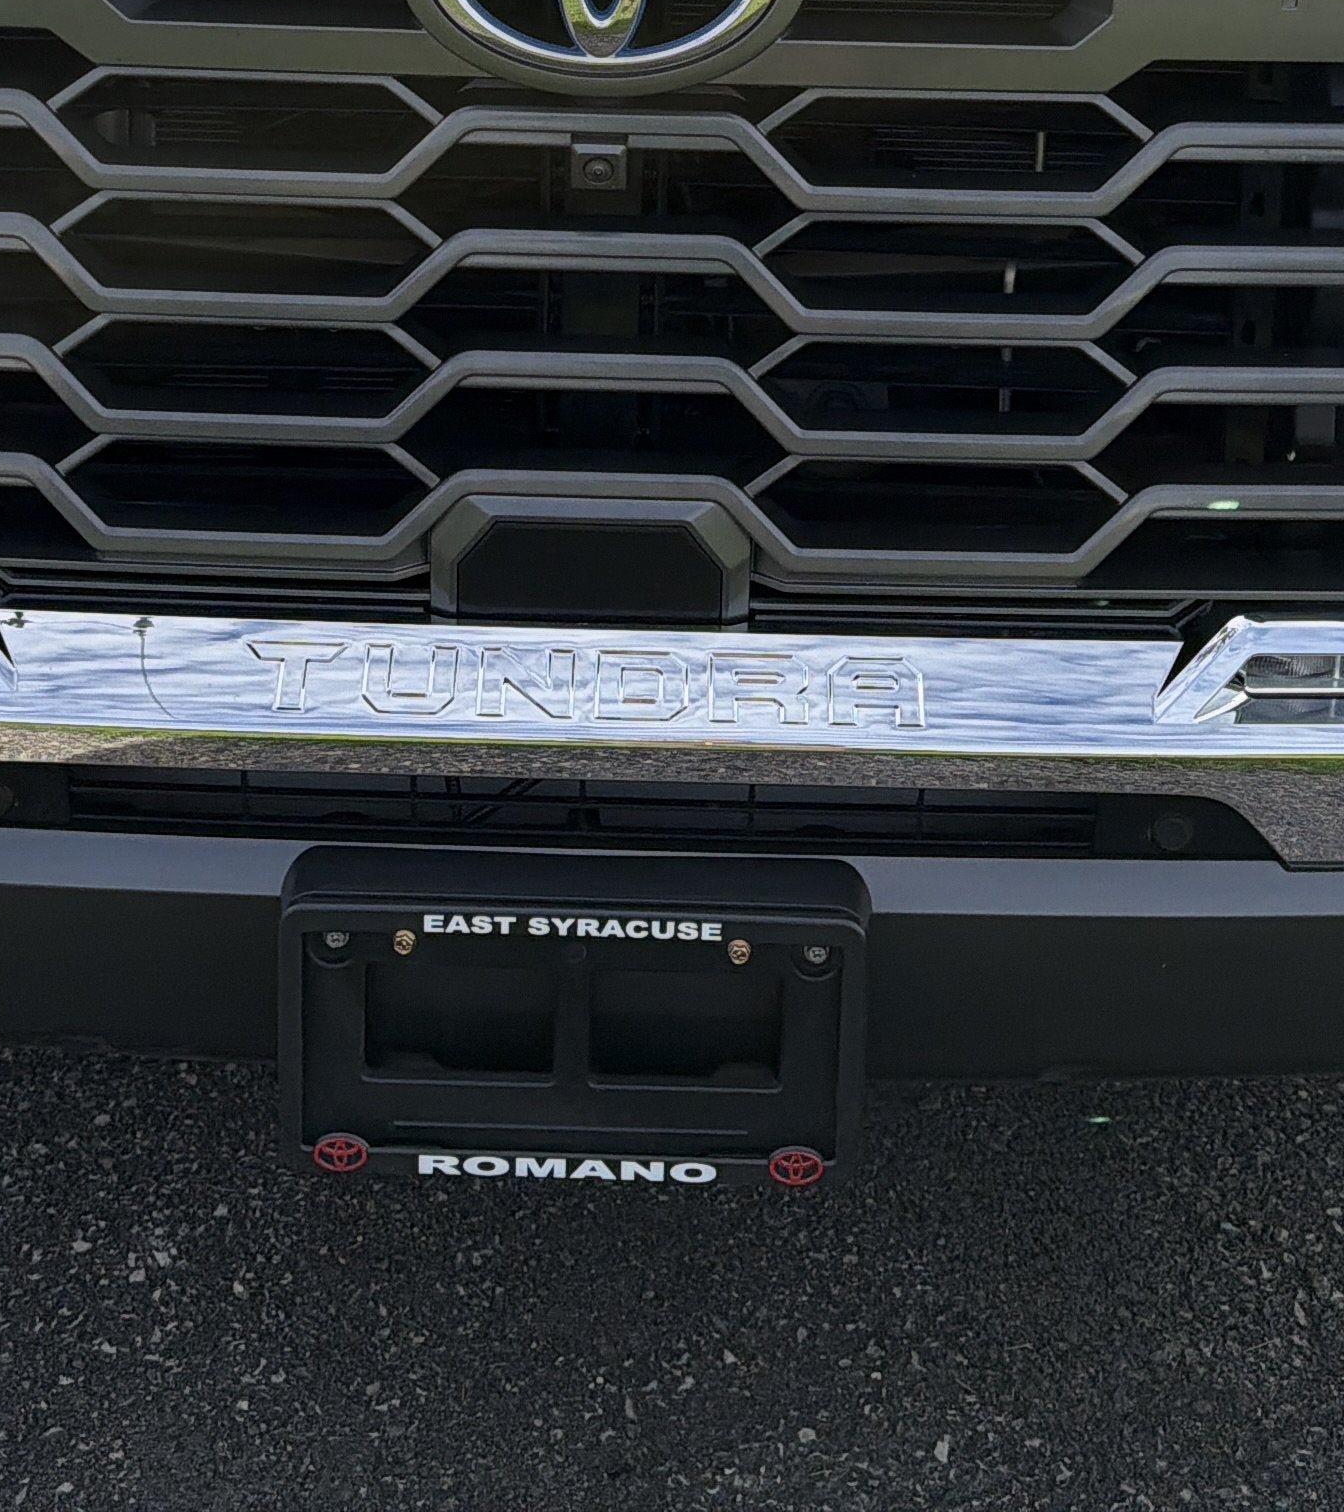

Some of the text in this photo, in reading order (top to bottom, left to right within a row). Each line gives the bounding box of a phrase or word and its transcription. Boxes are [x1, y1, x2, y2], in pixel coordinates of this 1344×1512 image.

[244, 638, 929, 731] TUNDRA
[422, 914, 723, 942] EAST SYRACUSE
[417, 1153, 718, 1185] ROMANO
